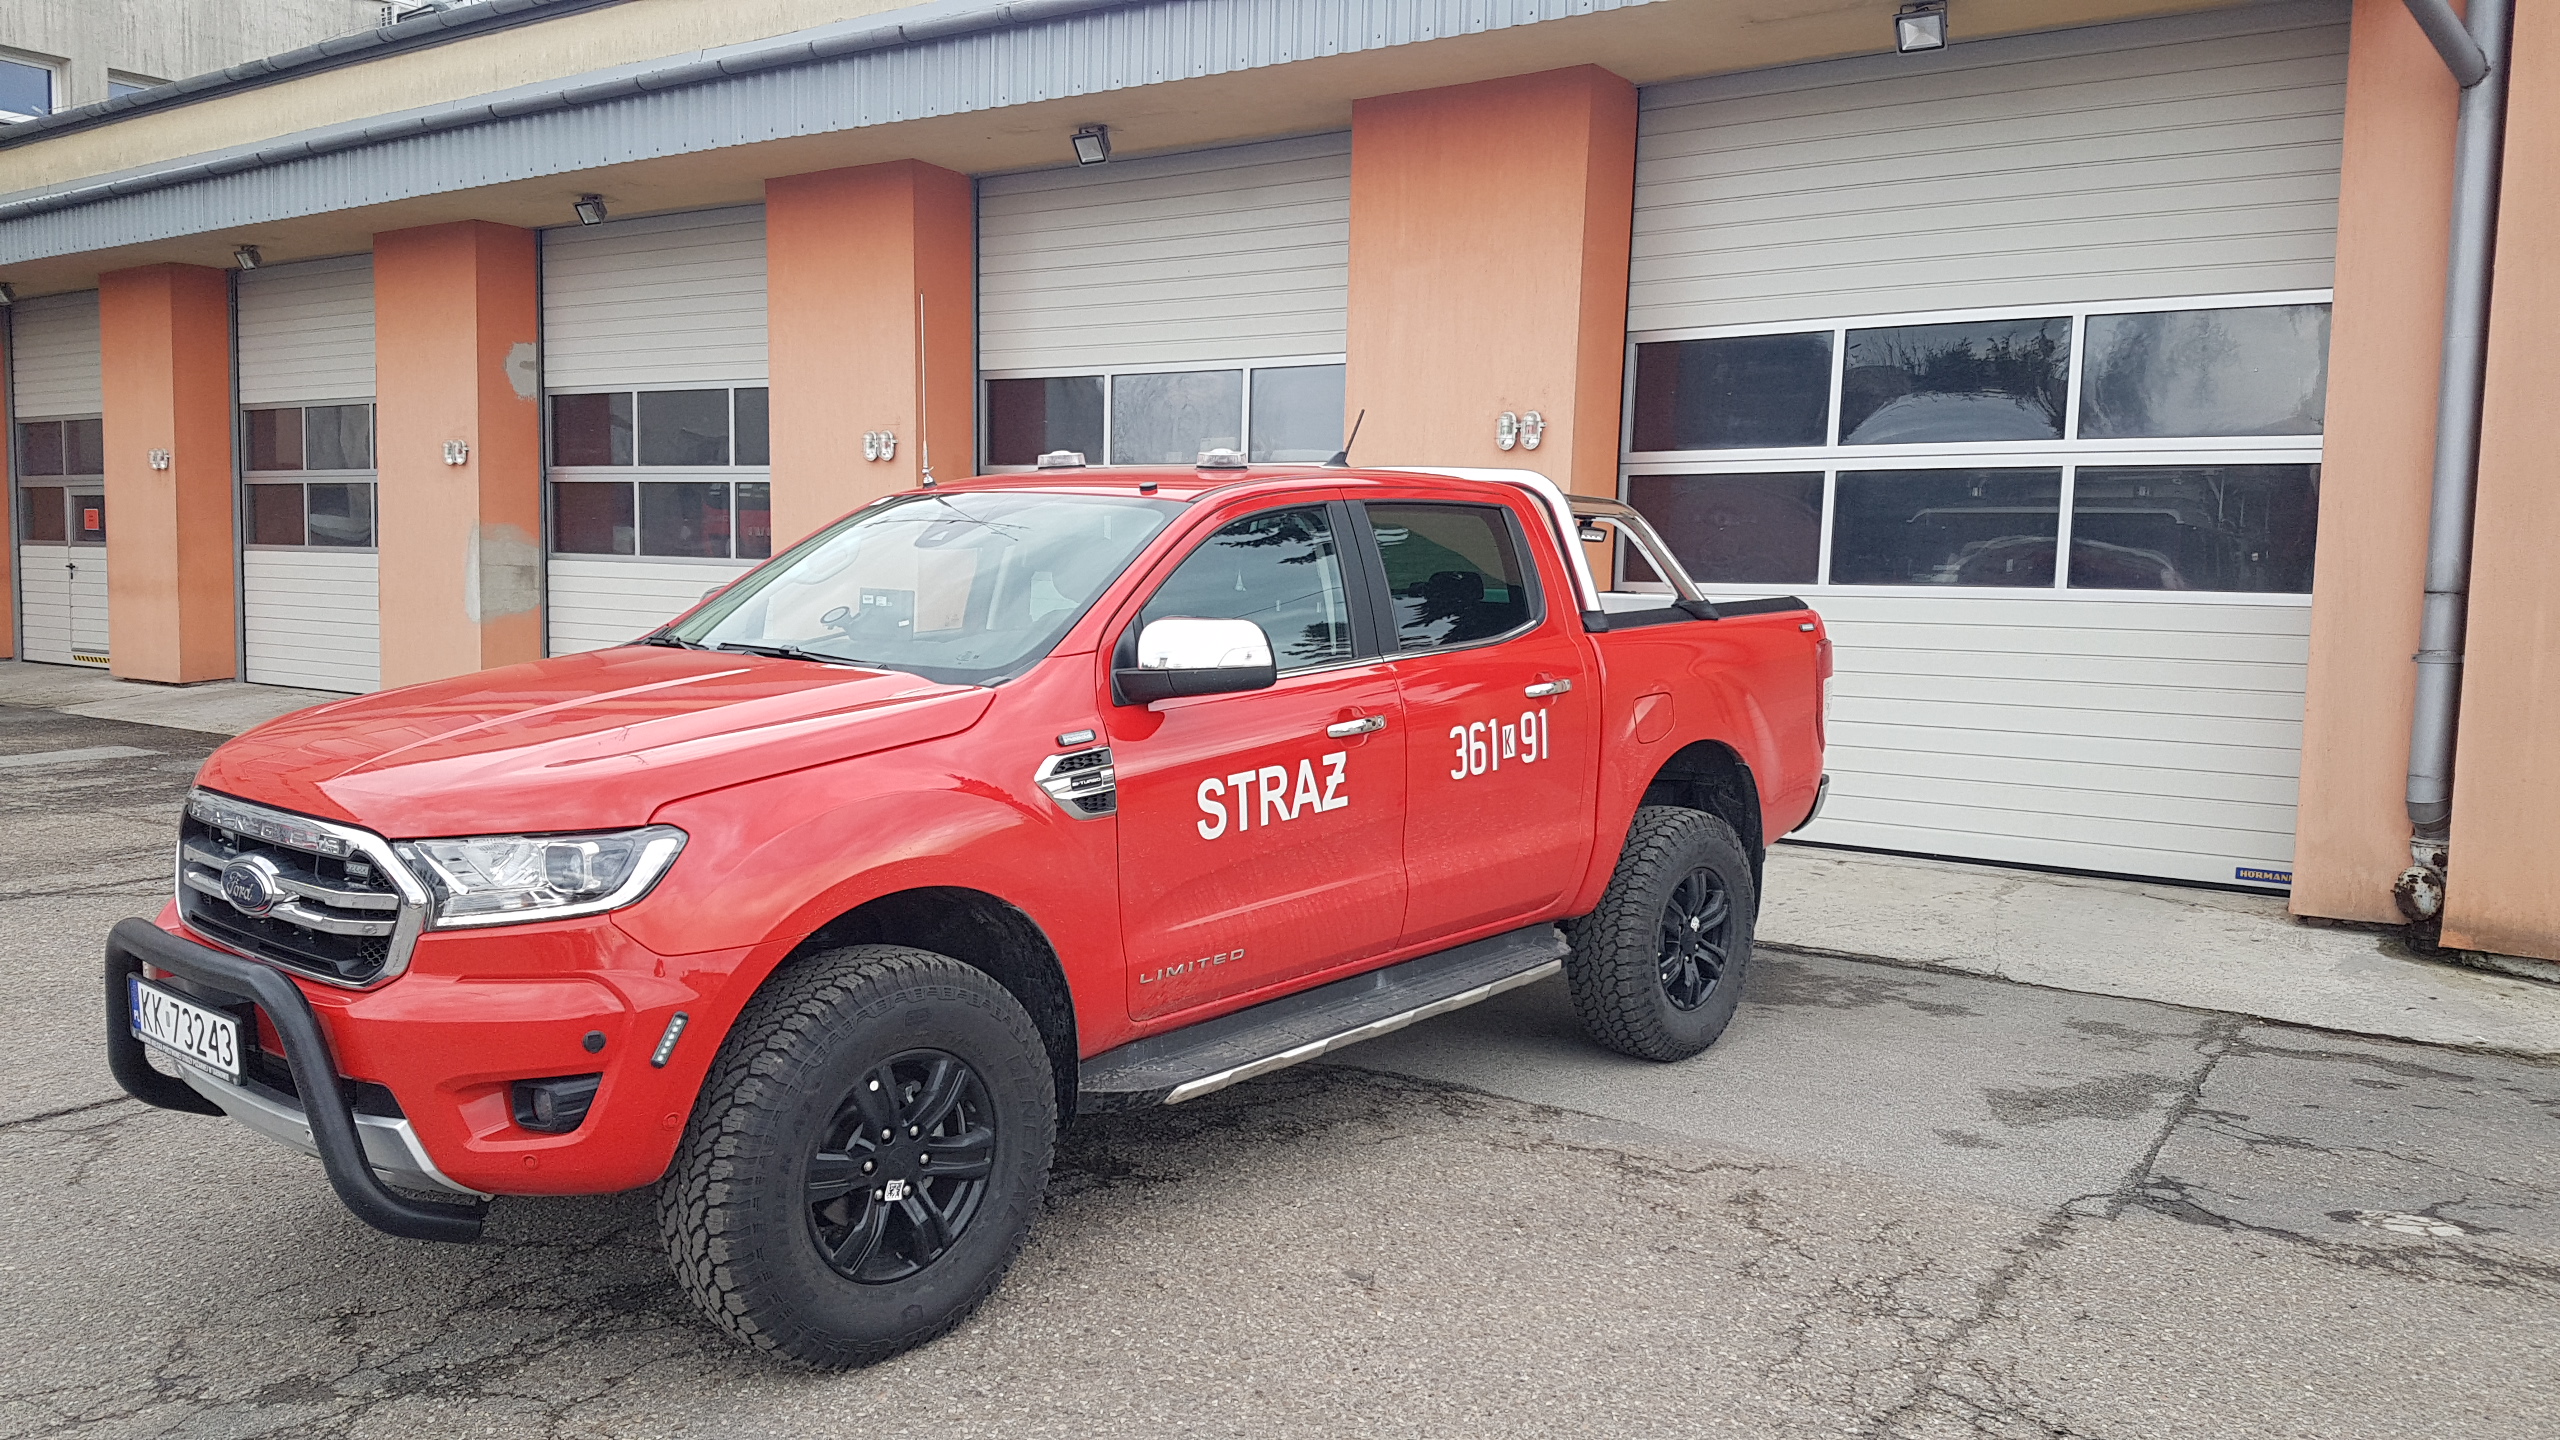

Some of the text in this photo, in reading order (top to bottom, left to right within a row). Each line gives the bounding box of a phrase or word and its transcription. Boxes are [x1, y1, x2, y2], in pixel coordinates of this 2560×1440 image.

[1197, 751, 1348, 841] STRAŻ
[226, 871, 254, 901] Ford
[1139, 948, 1245, 984] LIMITED
